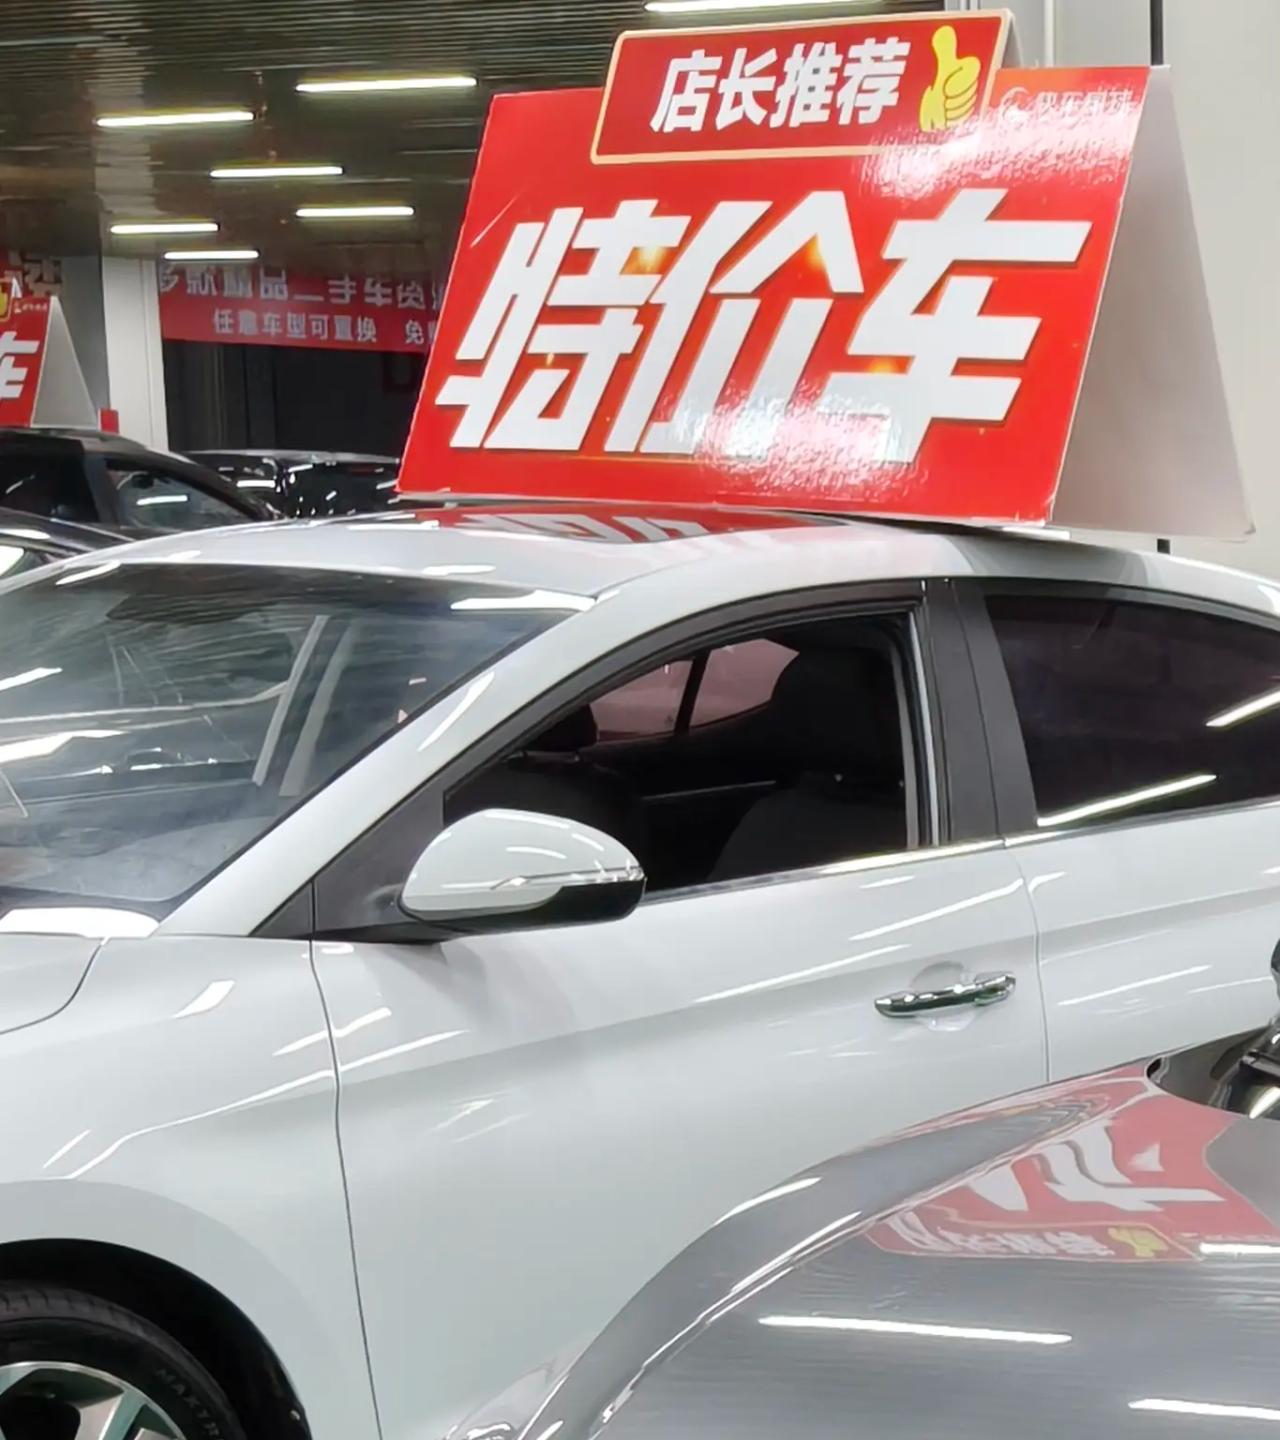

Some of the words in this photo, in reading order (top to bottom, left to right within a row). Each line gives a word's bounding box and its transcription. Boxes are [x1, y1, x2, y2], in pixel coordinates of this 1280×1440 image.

[650, 37, 911, 134] 店长推荐
[434, 187, 1093, 463] 特价车
